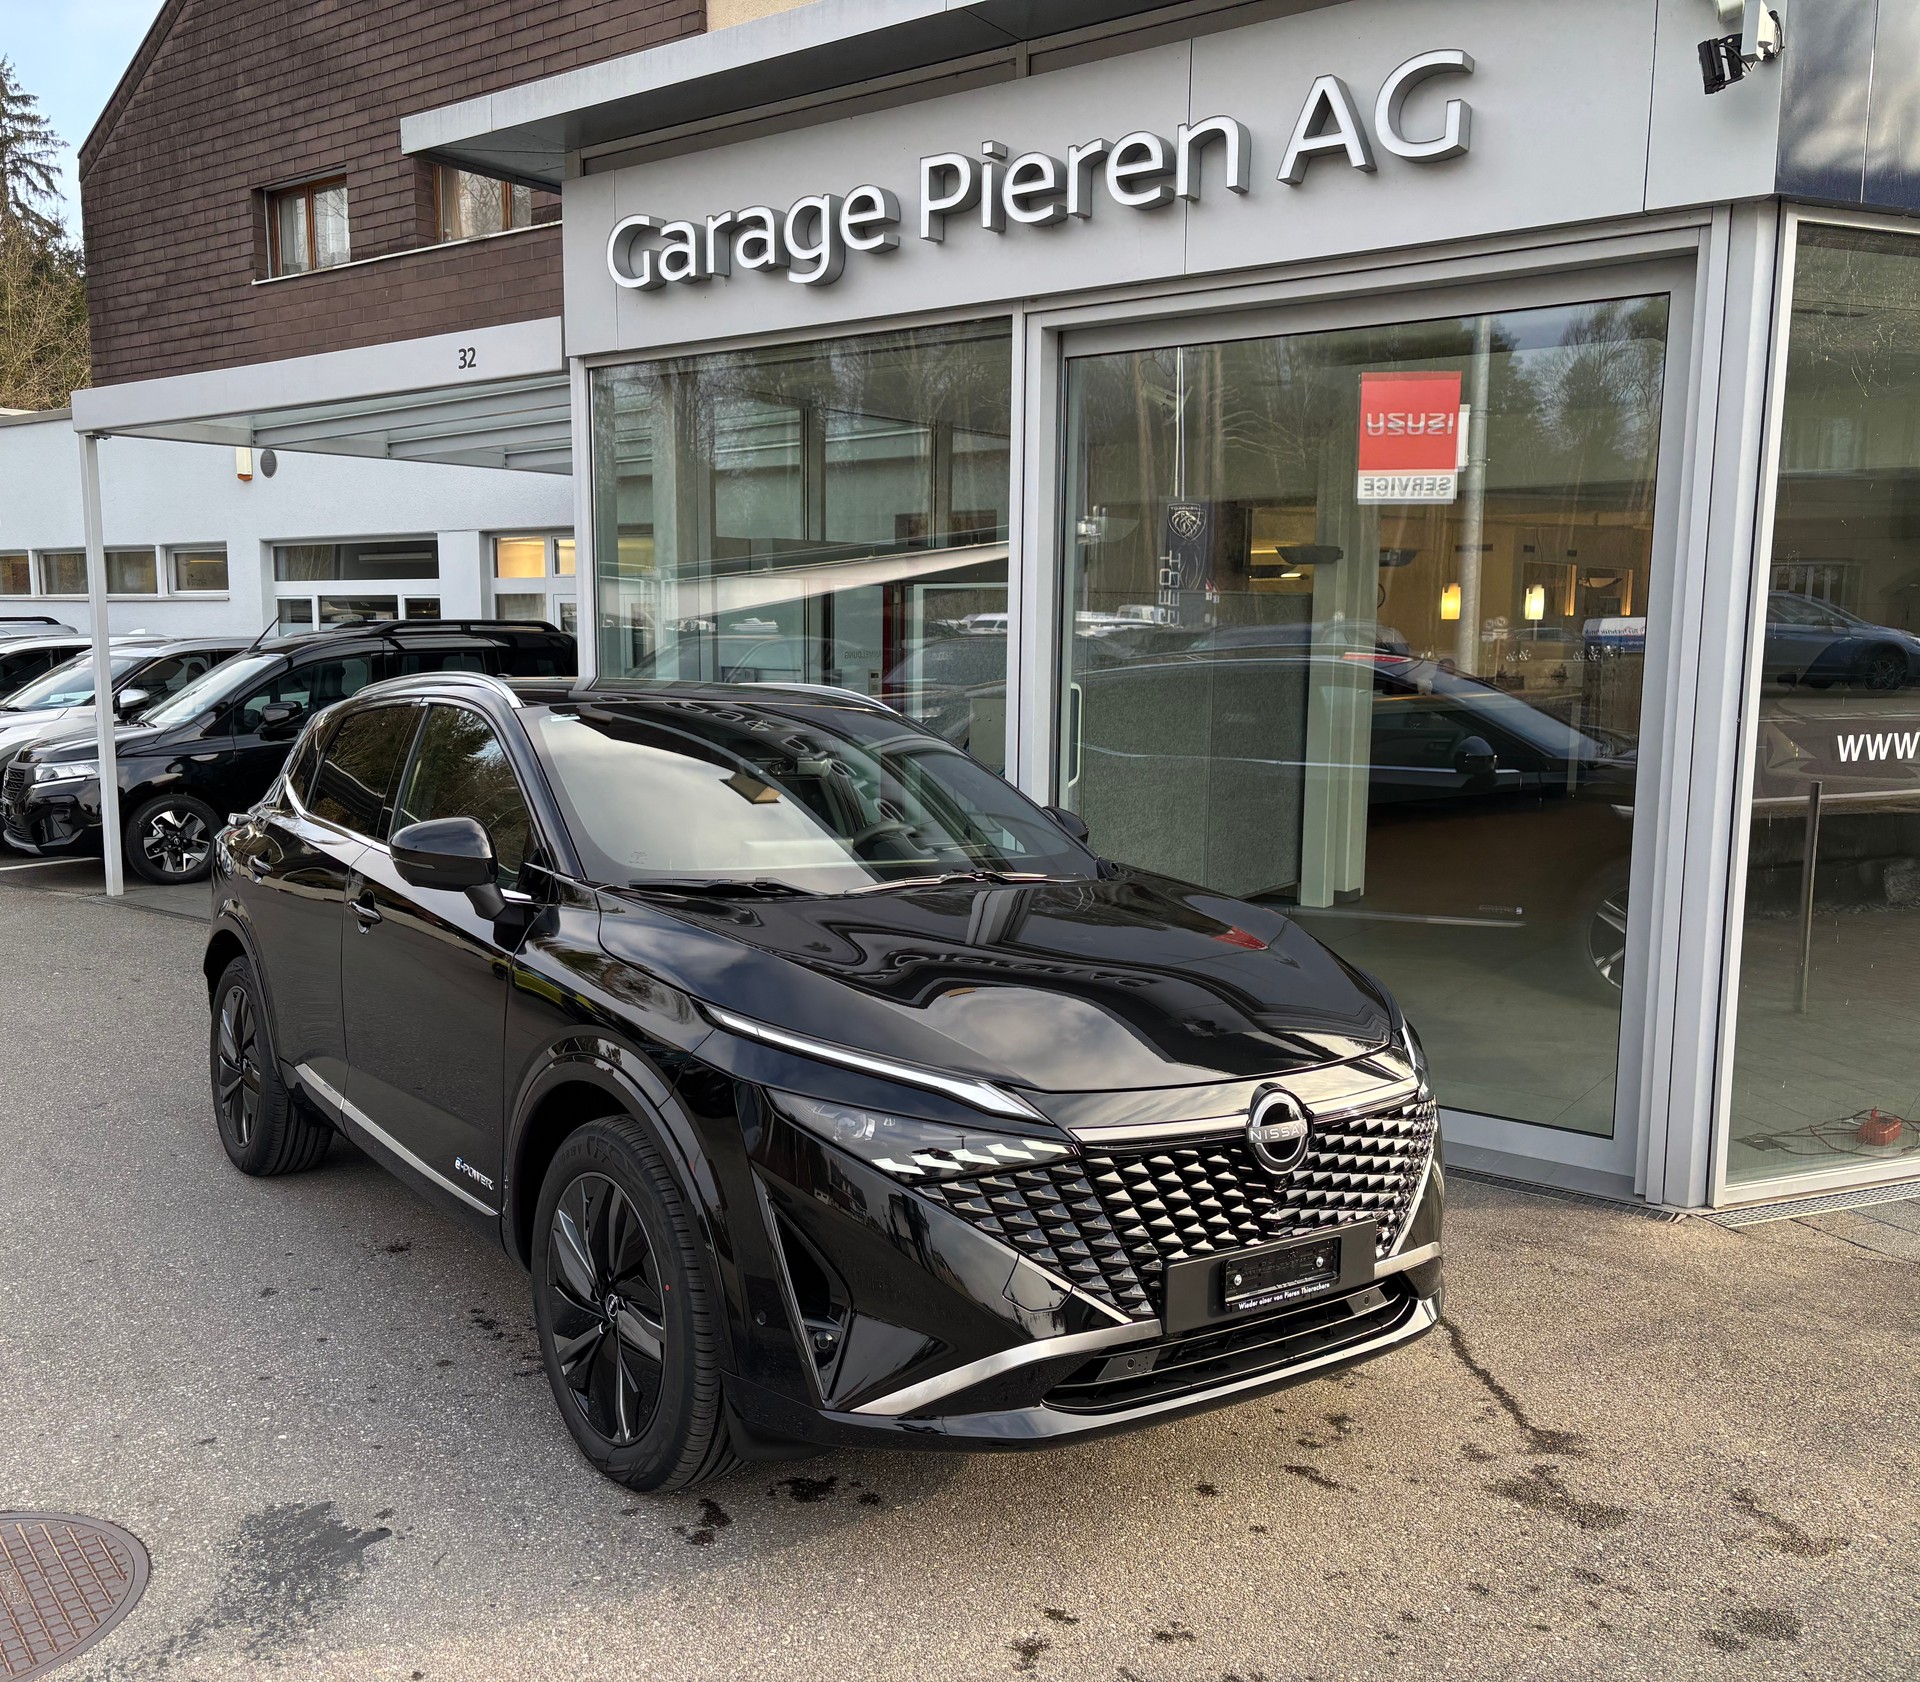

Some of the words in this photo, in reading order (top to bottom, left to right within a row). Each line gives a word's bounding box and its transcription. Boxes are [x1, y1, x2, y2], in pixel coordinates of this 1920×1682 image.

[606, 184, 899, 288] Garage
[919, 114, 1251, 243] Pieren
[1277, 48, 1475, 185] AG
[458, 346, 477, 370] 32
[1250, 1122, 1307, 1141] NISSAN
[1238, 1299, 1258, 1310] Wieder
[1259, 1296, 1272, 1305] einer
[1284, 1289, 1300, 1299] Pieren
